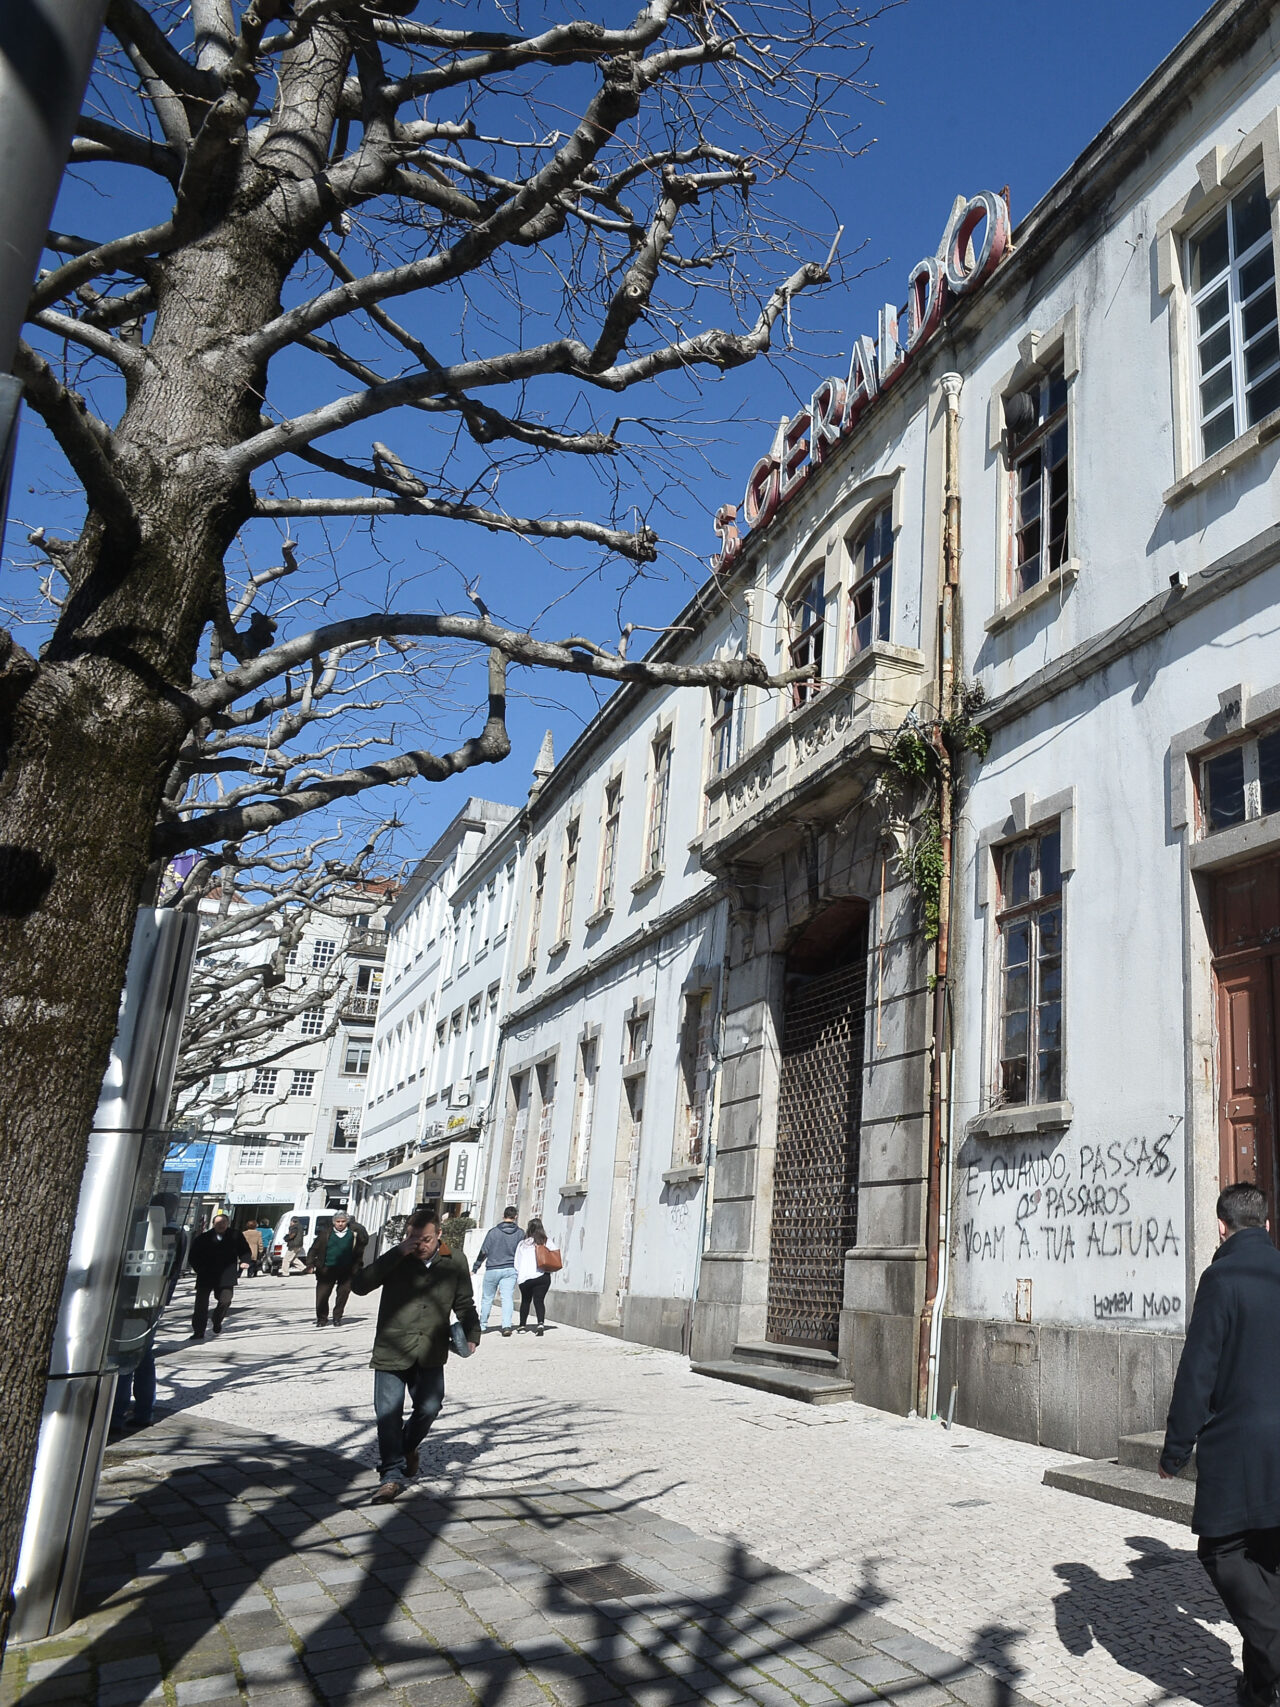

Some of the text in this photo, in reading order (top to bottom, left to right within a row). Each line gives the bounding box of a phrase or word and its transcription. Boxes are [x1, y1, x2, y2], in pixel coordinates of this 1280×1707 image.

[743, 189, 1010, 530] GERALDO
[1016, 1191, 1040, 1221] OS
[963, 1217, 1006, 1263] VOAM
[1039, 1225, 1076, 1264] TUA
[1086, 1217, 1181, 1258] ALTURA
[1093, 1291, 1181, 1318] HOMEM MUDO
